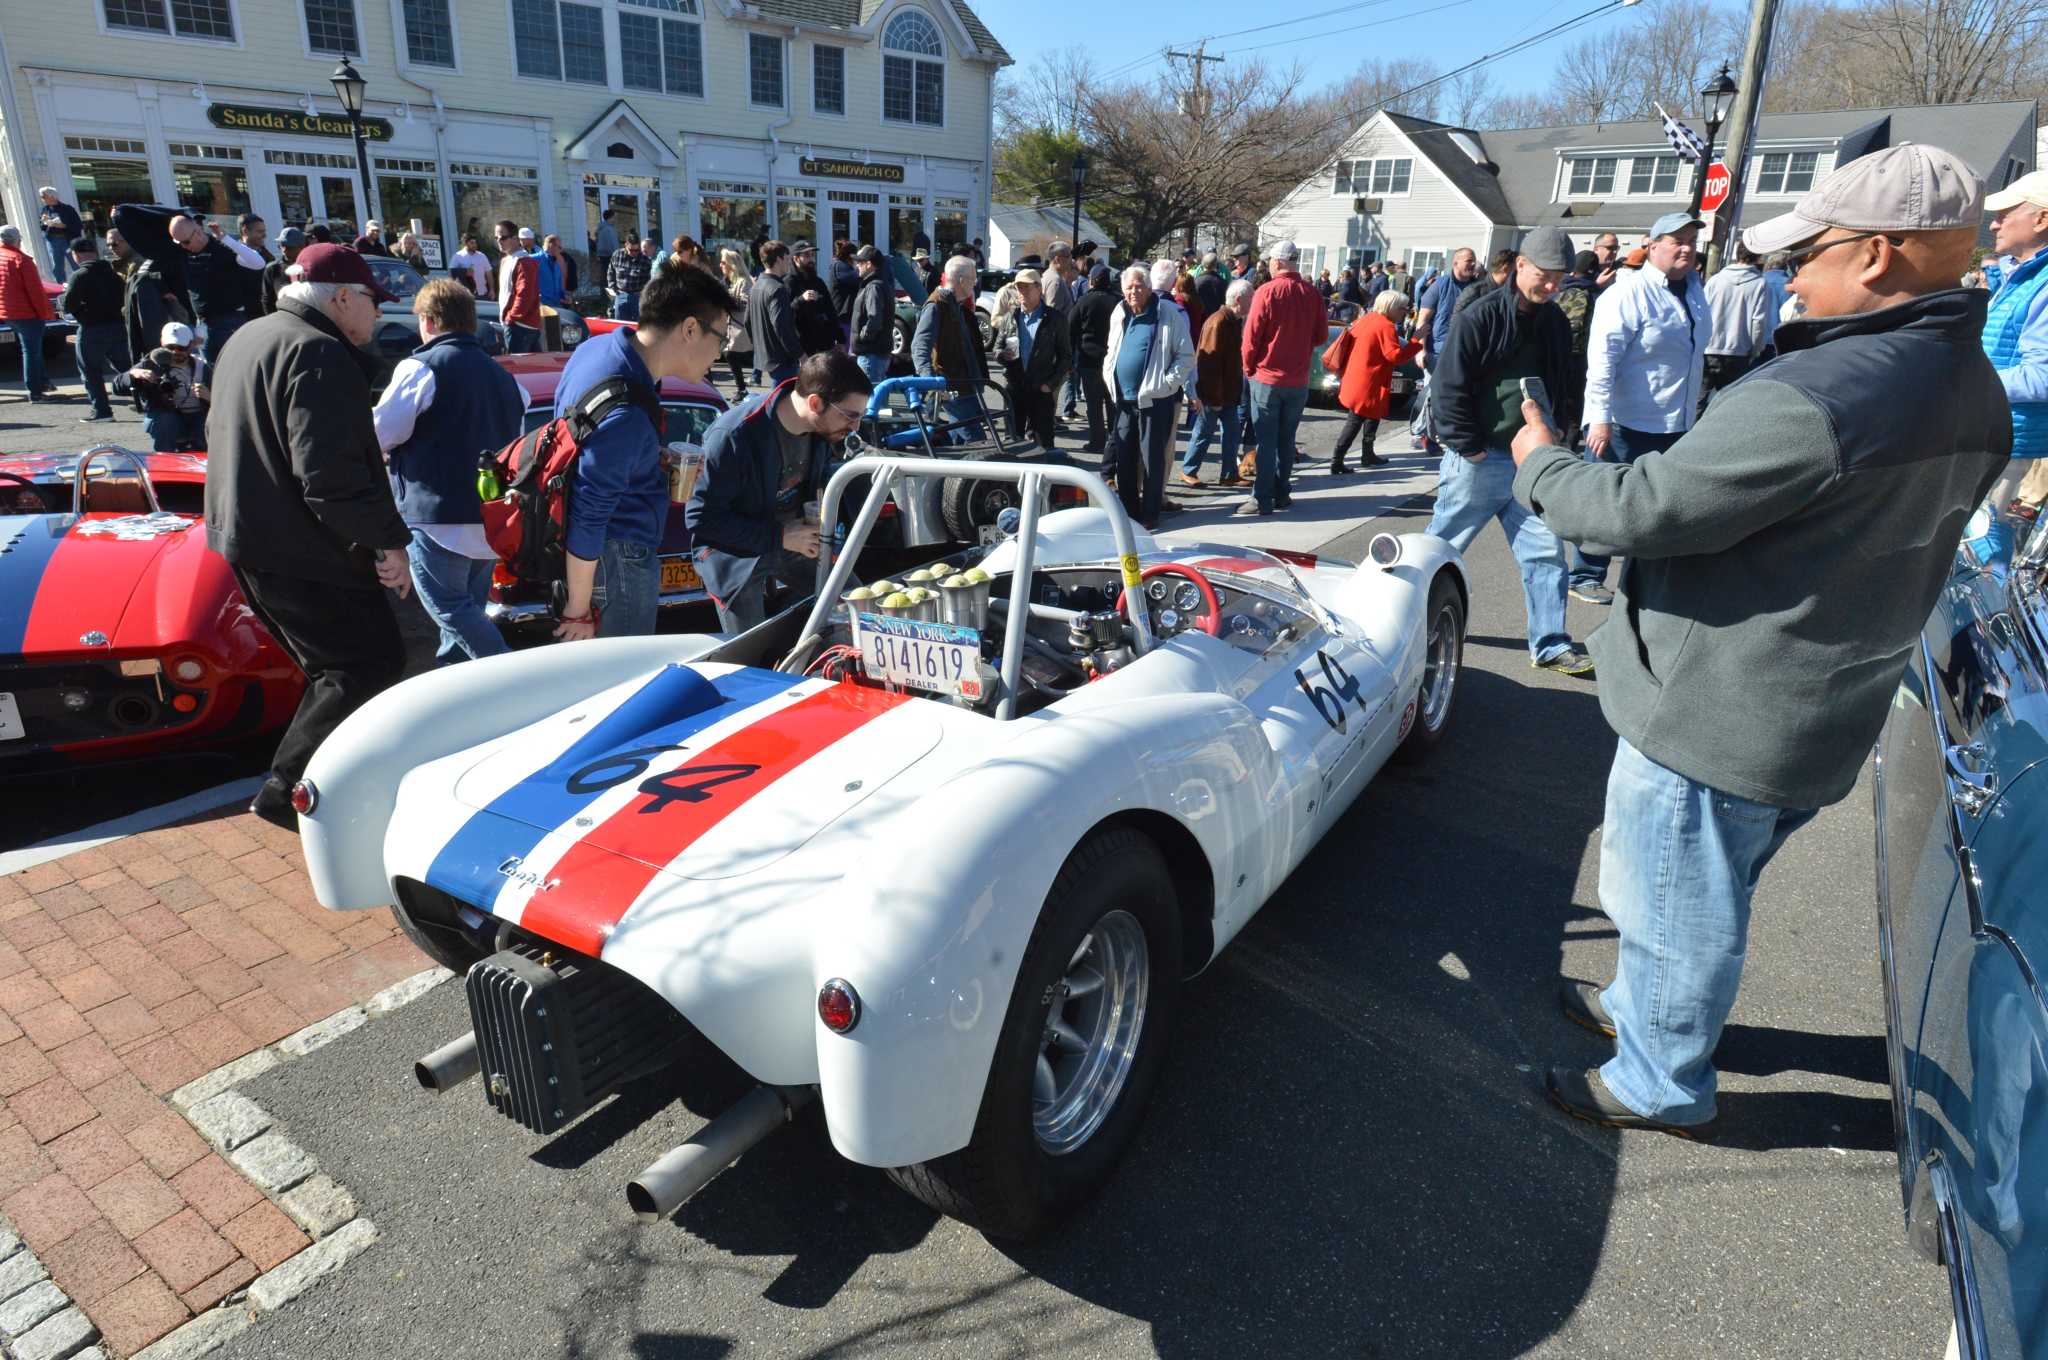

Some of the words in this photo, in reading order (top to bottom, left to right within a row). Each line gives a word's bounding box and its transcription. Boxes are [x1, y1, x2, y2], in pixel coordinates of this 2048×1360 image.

[223, 108, 299, 130] Sanda's
[803, 161, 818, 172] CT
[821, 162, 882, 177] SANDWICH
[1705, 176, 1728, 198] TOP
[886, 621, 912, 637] NEW
[915, 625, 949, 642] YORK
[874, 635, 963, 681] 8141619
[905, 678, 939, 690] DEALER
[1294, 649, 1367, 735] 64
[566, 744, 762, 814] 64
